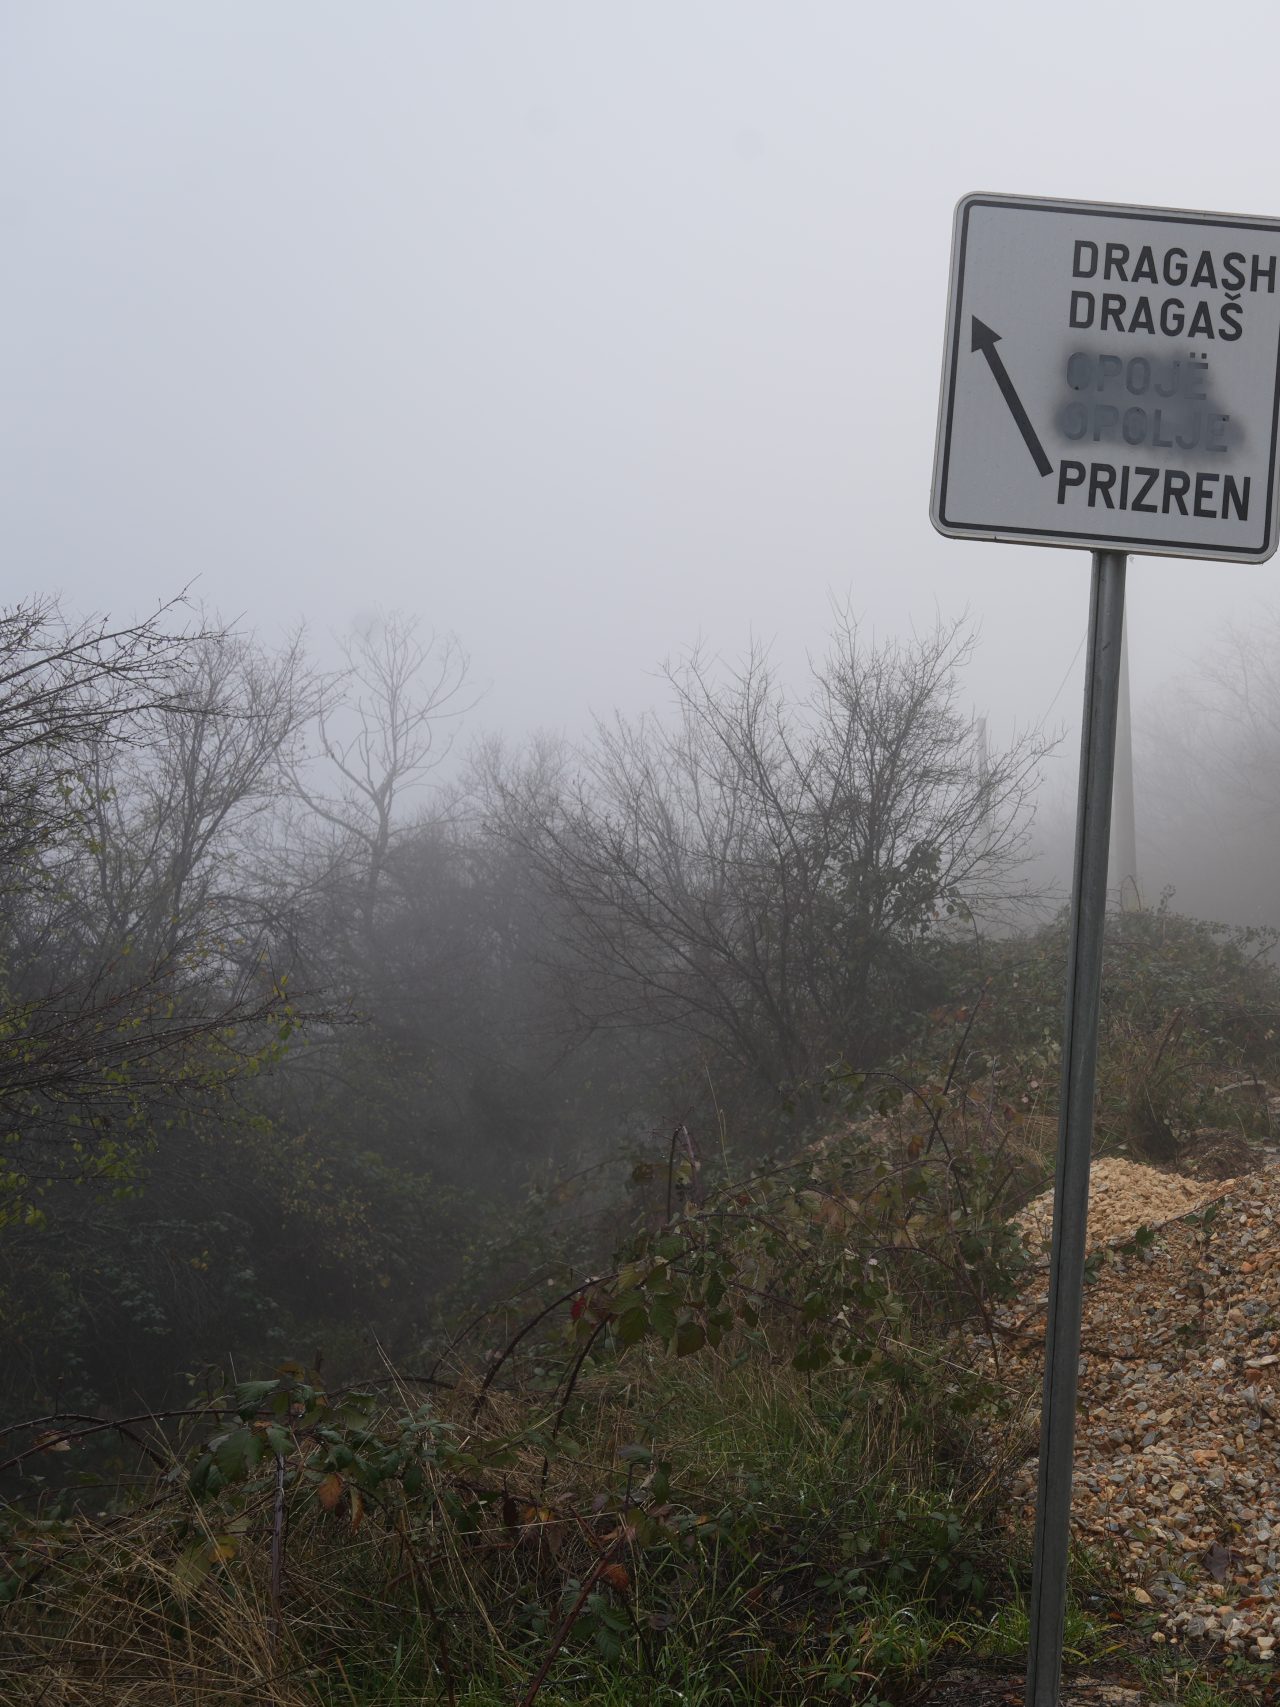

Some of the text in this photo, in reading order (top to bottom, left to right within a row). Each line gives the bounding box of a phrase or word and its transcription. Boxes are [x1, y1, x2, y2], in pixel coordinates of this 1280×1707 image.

[1072, 240, 1277, 293] DRAGASH
[1069, 290, 1243, 342] DRAGAŠ
[1057, 460, 1251, 521] PRIZREN
